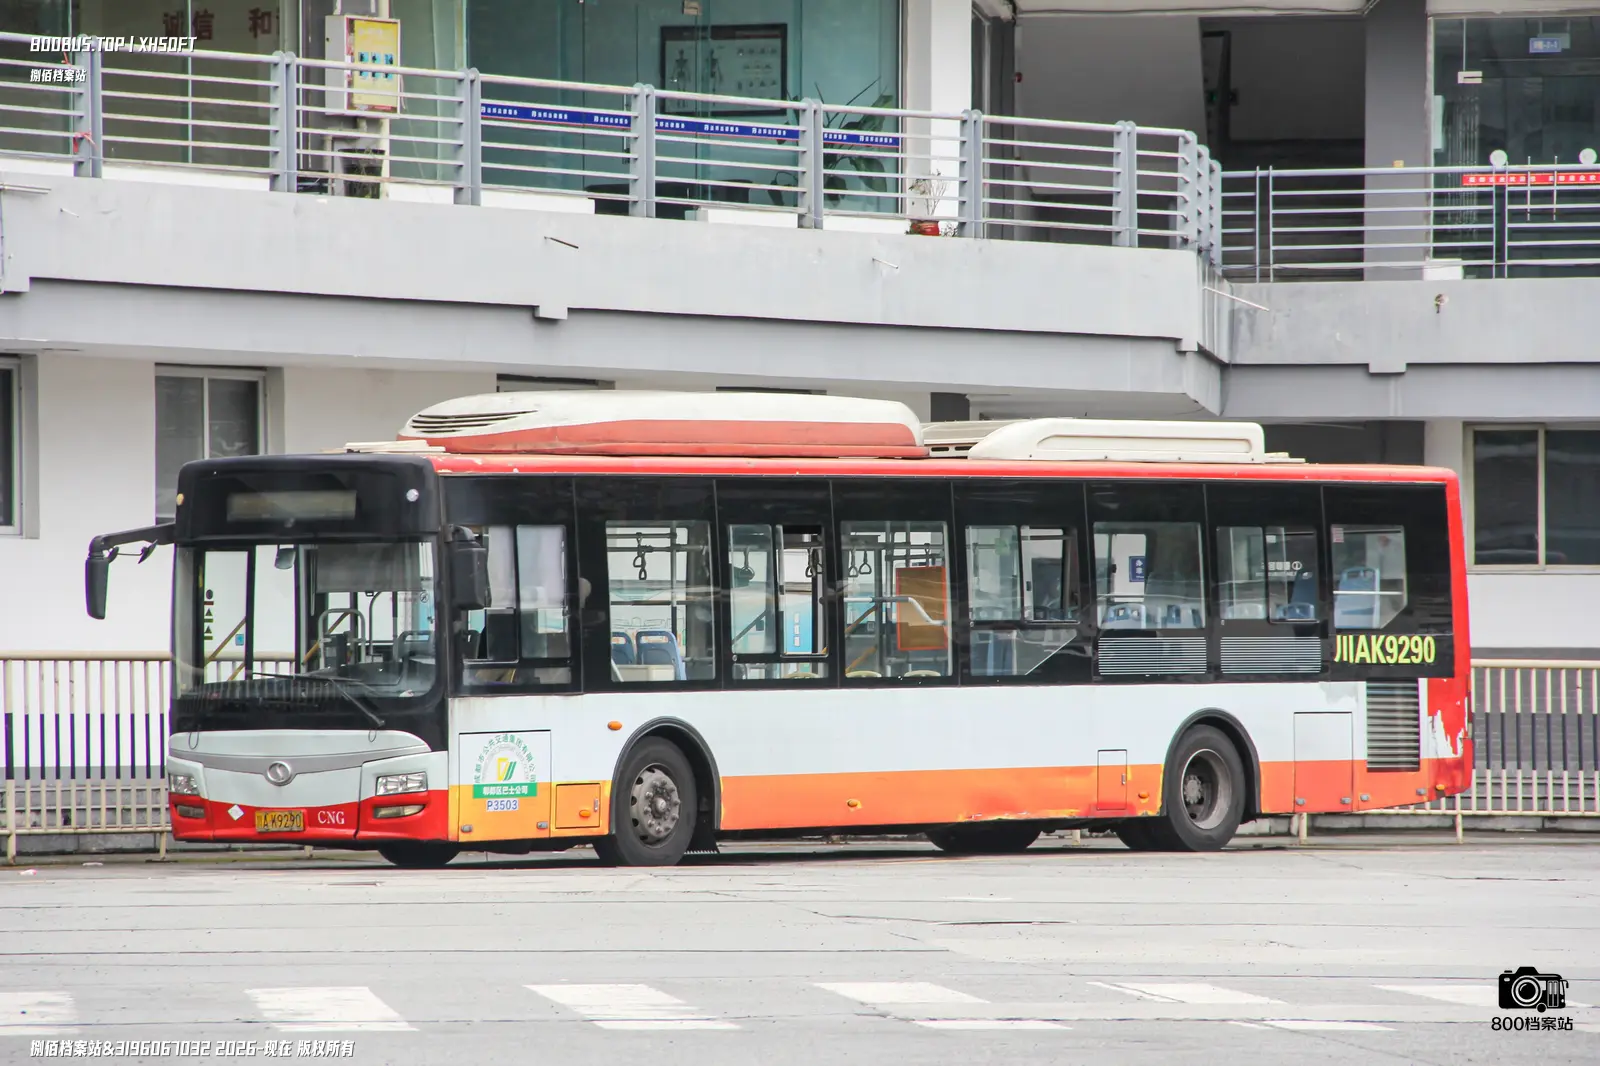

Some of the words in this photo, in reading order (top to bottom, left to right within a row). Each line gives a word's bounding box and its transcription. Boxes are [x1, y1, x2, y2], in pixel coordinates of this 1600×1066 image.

[248, 7, 280, 39] 和
[486, 799, 518, 811] P3503
[317, 810, 345, 825] CNG
